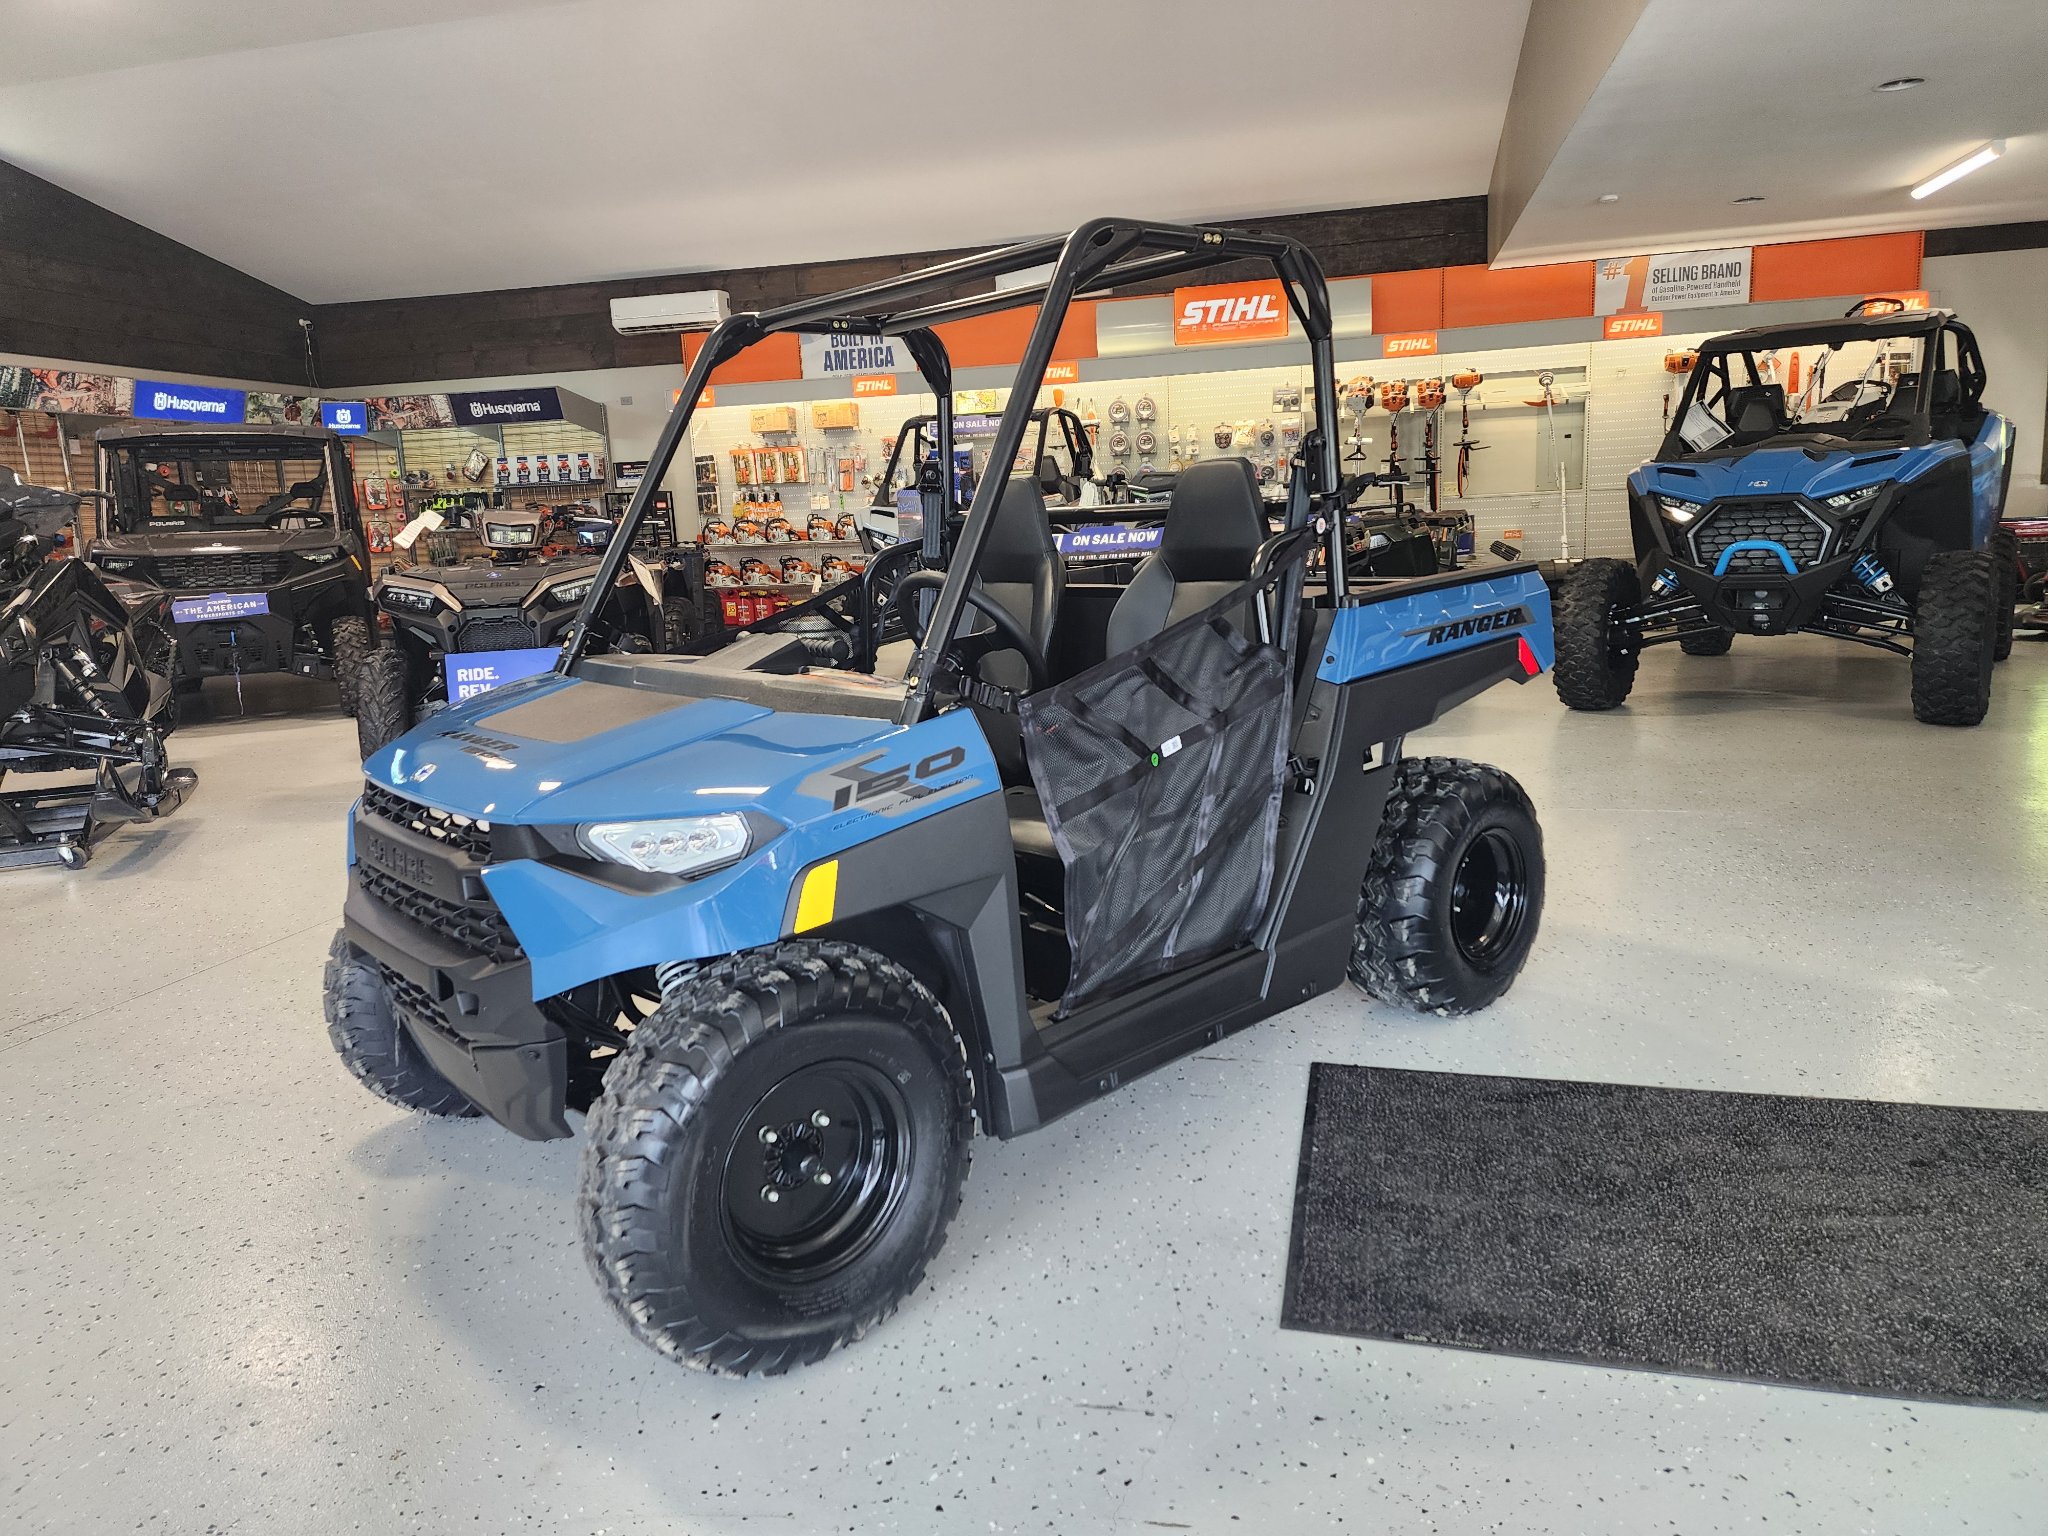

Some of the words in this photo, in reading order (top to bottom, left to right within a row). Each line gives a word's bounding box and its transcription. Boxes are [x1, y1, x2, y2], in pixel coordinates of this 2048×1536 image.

[1652, 265, 1699, 284] SELLING
[1701, 261, 1742, 280] BRAND
[1651, 286, 1658, 294] of
[1659, 282, 1712, 294] Gasoline-Powered
[1713, 279, 1741, 289] Handheld
[1651, 294, 1670, 302] Outdoor
[1687, 290, 1713, 299] Equipment
[1720, 288, 1741, 297] America
[1180, 294, 1280, 325] STIHL
[1609, 318, 1658, 333] STIHL
[1387, 337, 1431, 352] STIHL
[824, 346, 895, 371] AMERICA
[1046, 366, 1074, 379] TIHL
[855, 380, 892, 392] STIHL
[167, 395, 226, 413] Husqvarna
[482, 401, 541, 415] Husqvarna
[328, 422, 361, 430] Husqvarna
[953, 421, 965, 429] ON
[966, 420, 988, 428] SALE
[988, 419, 1003, 427] NO
[1072, 535, 1090, 546] ON
[1091, 532, 1126, 545] SALE
[1127, 530, 1159, 543] NOW
[183, 606, 203, 615] THE
[206, 600, 257, 613] AMERICAN
[1427, 607, 1527, 646] RANGER
[457, 667, 499, 682] RIDE.
[832, 746, 966, 812] 150
[832, 803, 894, 832] ELECTRONIC
